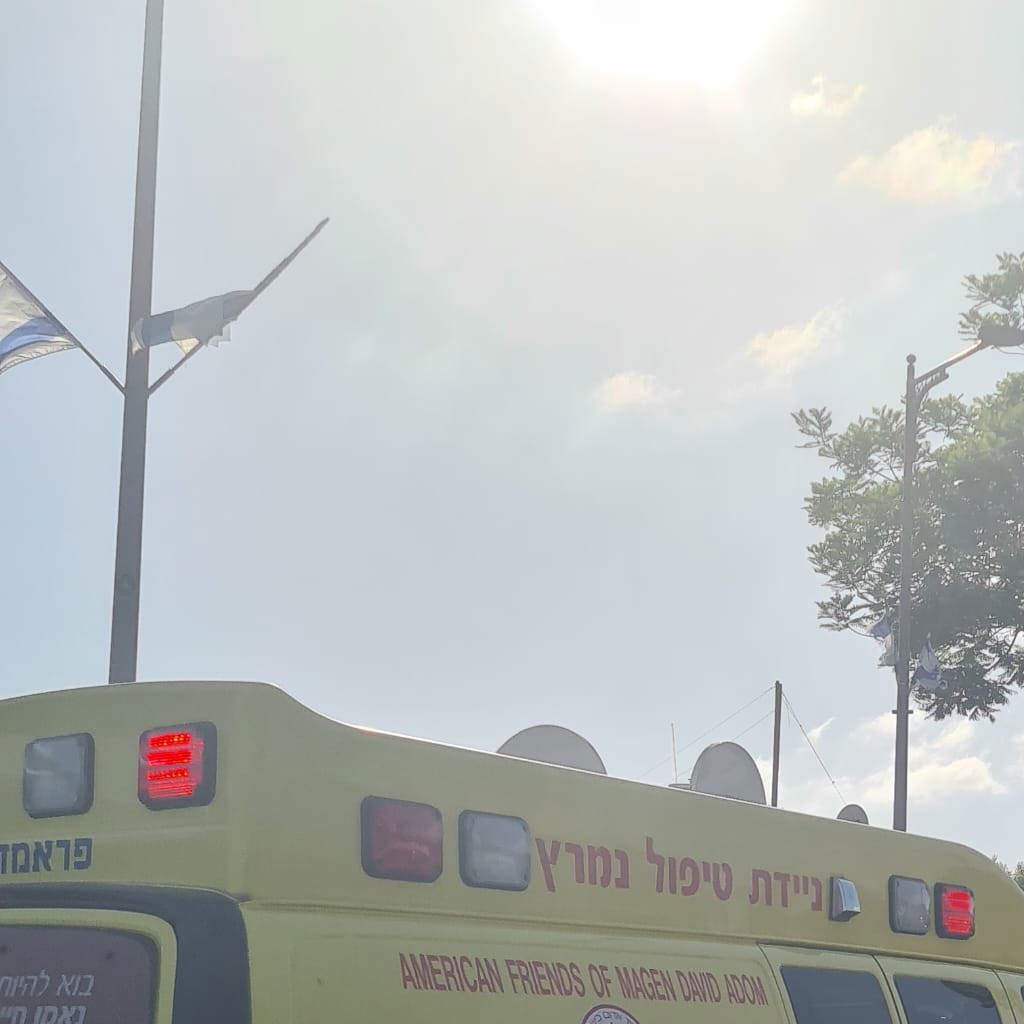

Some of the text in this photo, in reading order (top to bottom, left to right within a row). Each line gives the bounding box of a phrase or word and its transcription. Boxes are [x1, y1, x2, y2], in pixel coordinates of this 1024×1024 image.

[535, 836, 823, 912] ניידת טיפול נמרץ
[56, 974, 95, 997] בוא
[399, 952, 769, 1006] AMERICAN FRIENDS OF MAGEN DAVID ADOM
